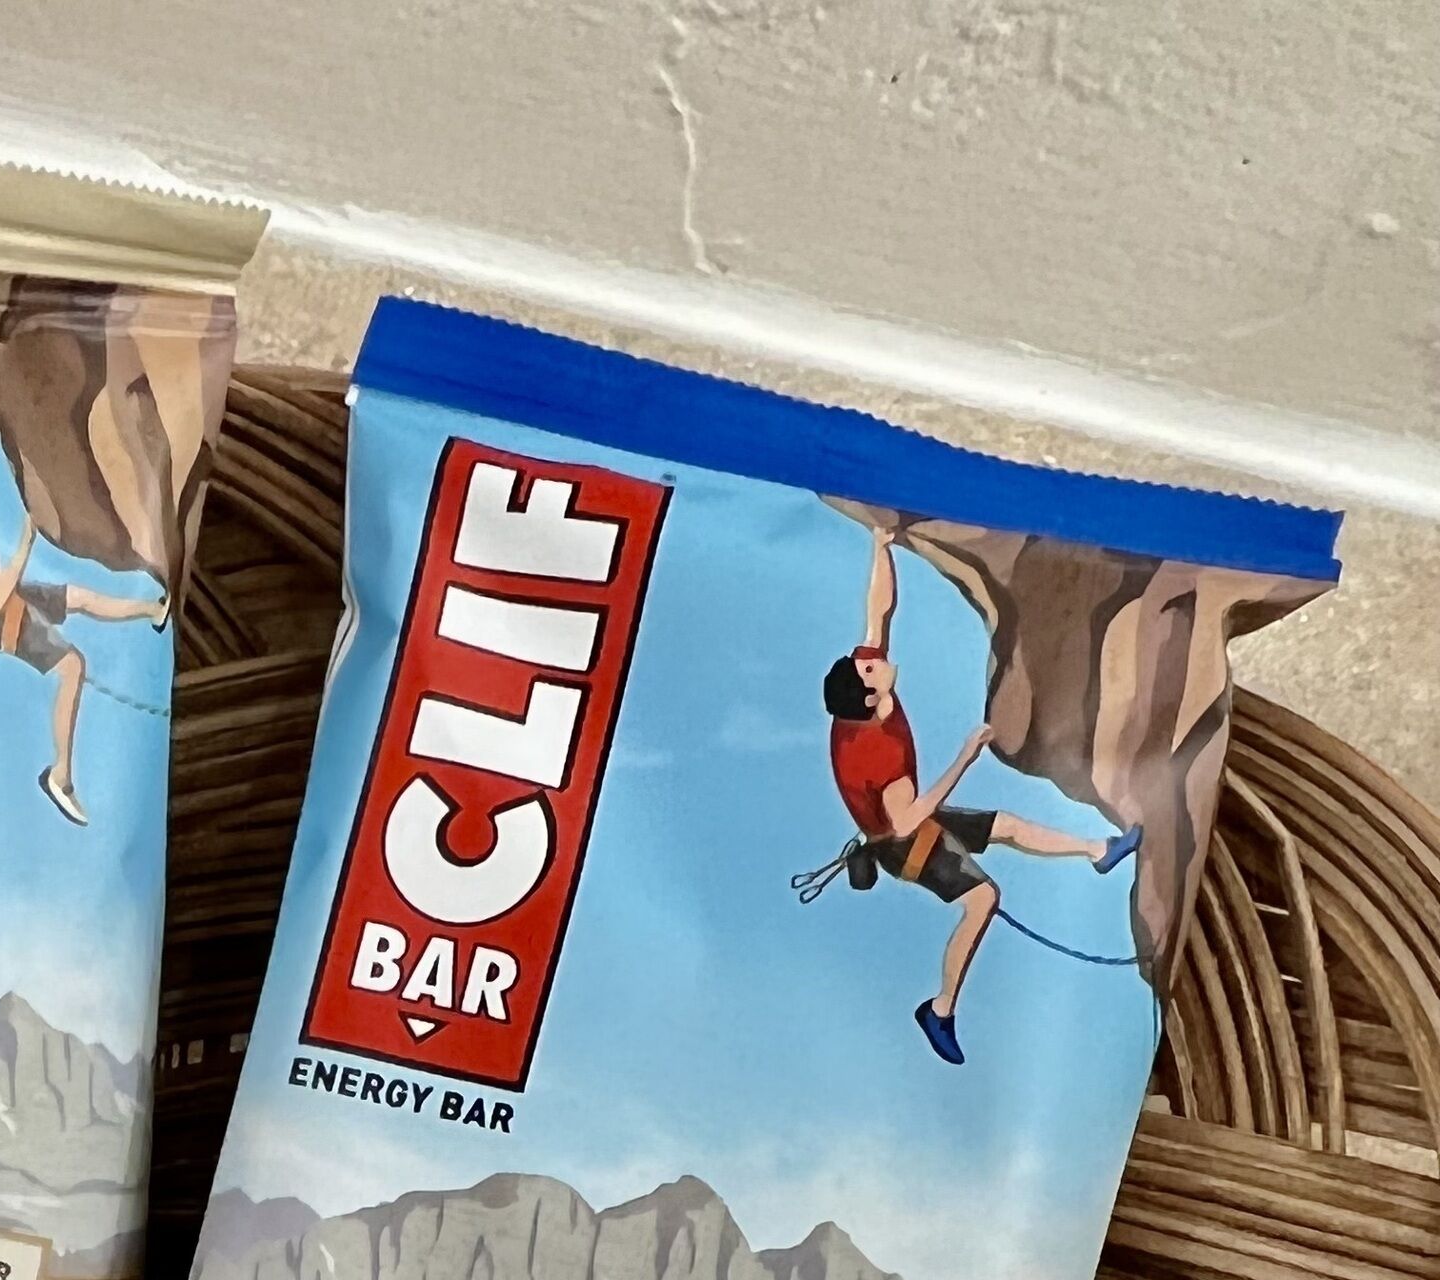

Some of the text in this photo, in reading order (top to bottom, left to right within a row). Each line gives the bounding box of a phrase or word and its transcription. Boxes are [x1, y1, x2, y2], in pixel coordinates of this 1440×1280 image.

[385, 461, 624, 924] CLIF
[350, 920, 519, 1021] BAR
[287, 1056, 515, 1134] ENERGY BAR
